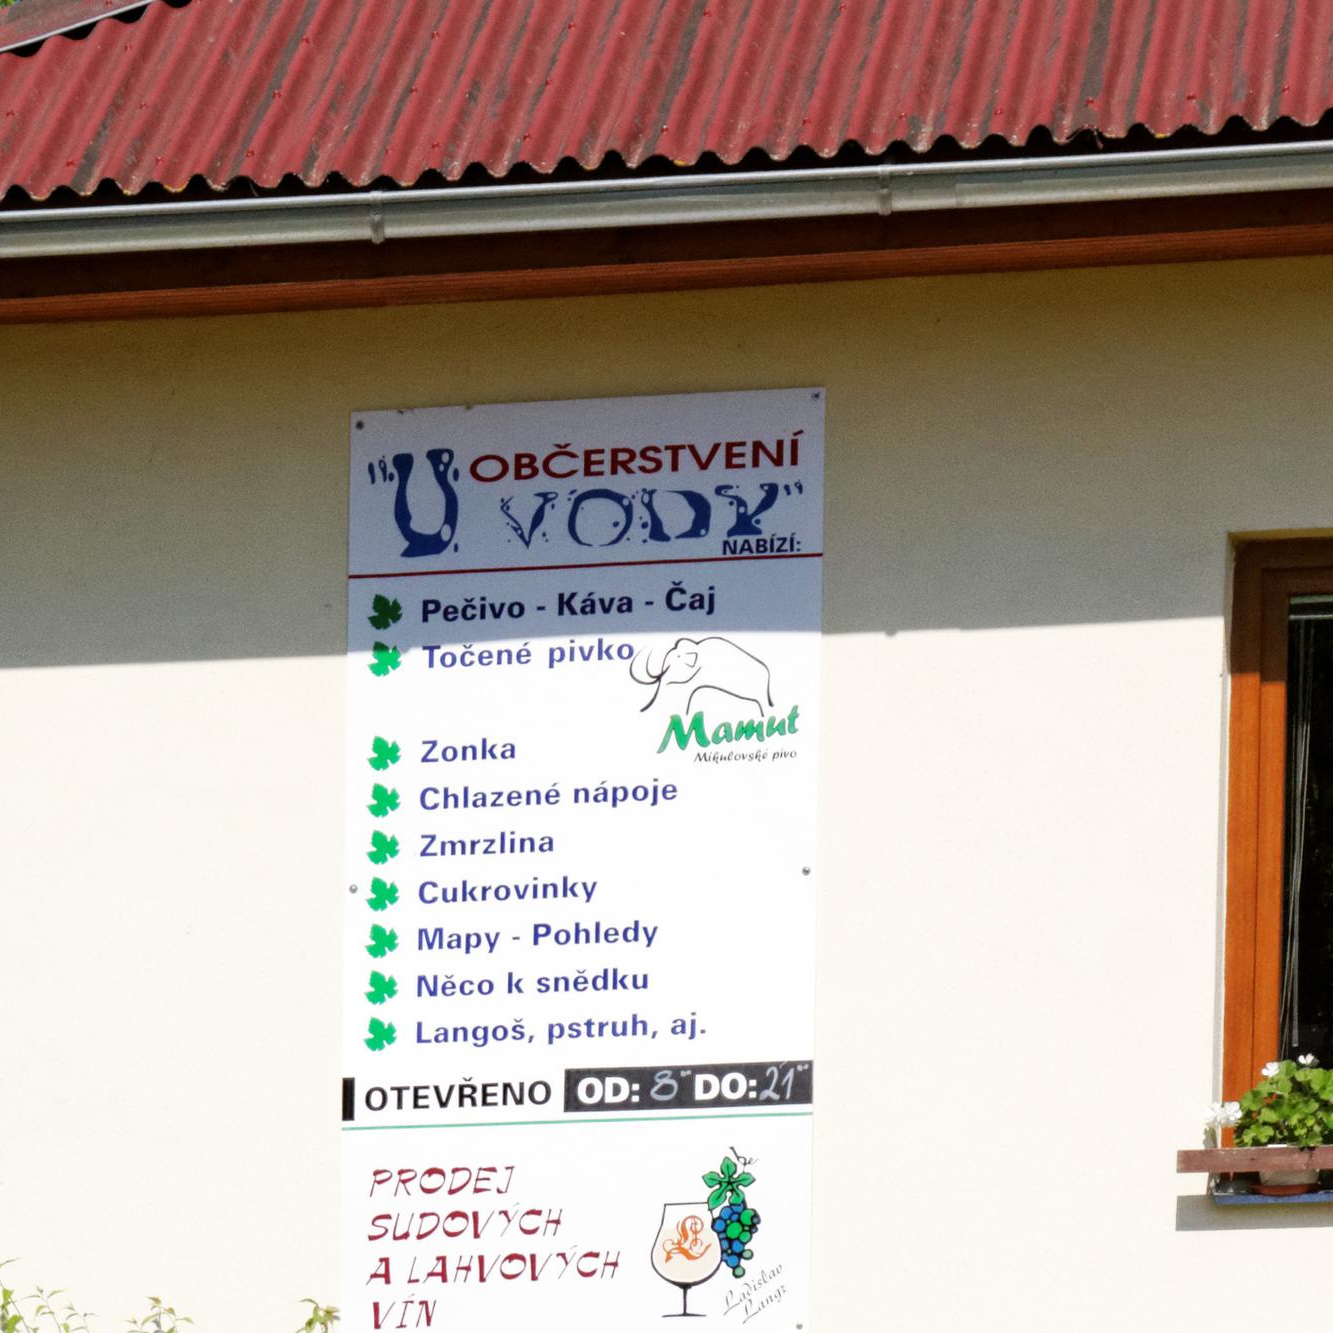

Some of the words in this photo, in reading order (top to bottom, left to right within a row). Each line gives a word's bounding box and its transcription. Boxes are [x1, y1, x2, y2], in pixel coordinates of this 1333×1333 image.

[469, 430, 805, 483] OBČERSTVENÍ
[722, 536, 803, 556] NABÍZÍ:
[421, 596, 526, 624] Pečivo
[557, 592, 634, 617] Káva
[665, 581, 716, 616] Čaj
[421, 641, 533, 670] Točené
[548, 638, 635, 670] pivko
[656, 704, 800, 754] Mamut
[420, 737, 517, 764] Zonka
[693, 748, 769, 765] Mikulovské
[772, 748, 798, 762] pivo
[419, 781, 561, 811] Chlazené
[572, 778, 679, 808] nápoje
[419, 831, 555, 858] Zmrzlina
[417, 876, 598, 906] Cukrovinky
[416, 927, 501, 955] Mapy
[532, 920, 659, 948] Pohledy
[416, 973, 494, 999] Něco
[506, 971, 524, 996] k
[535, 968, 650, 994] snědku
[415, 1018, 535, 1049] Langoš,
[546, 1013, 658, 1046] pstruh,
[670, 1011, 708, 1040] aj.
[363, 1077, 553, 1112] OTEVŘENO
[576, 1076, 640, 1105] OD:
[694, 1072, 757, 1101] DO:
[369, 1165, 516, 1198] PRODEJ
[367, 1202, 564, 1241] SUDOVÝCH
[366, 1256, 392, 1286] A
[407, 1245, 621, 1284] LAHVOVÝCH
[372, 1293, 438, 1330] VÍN
